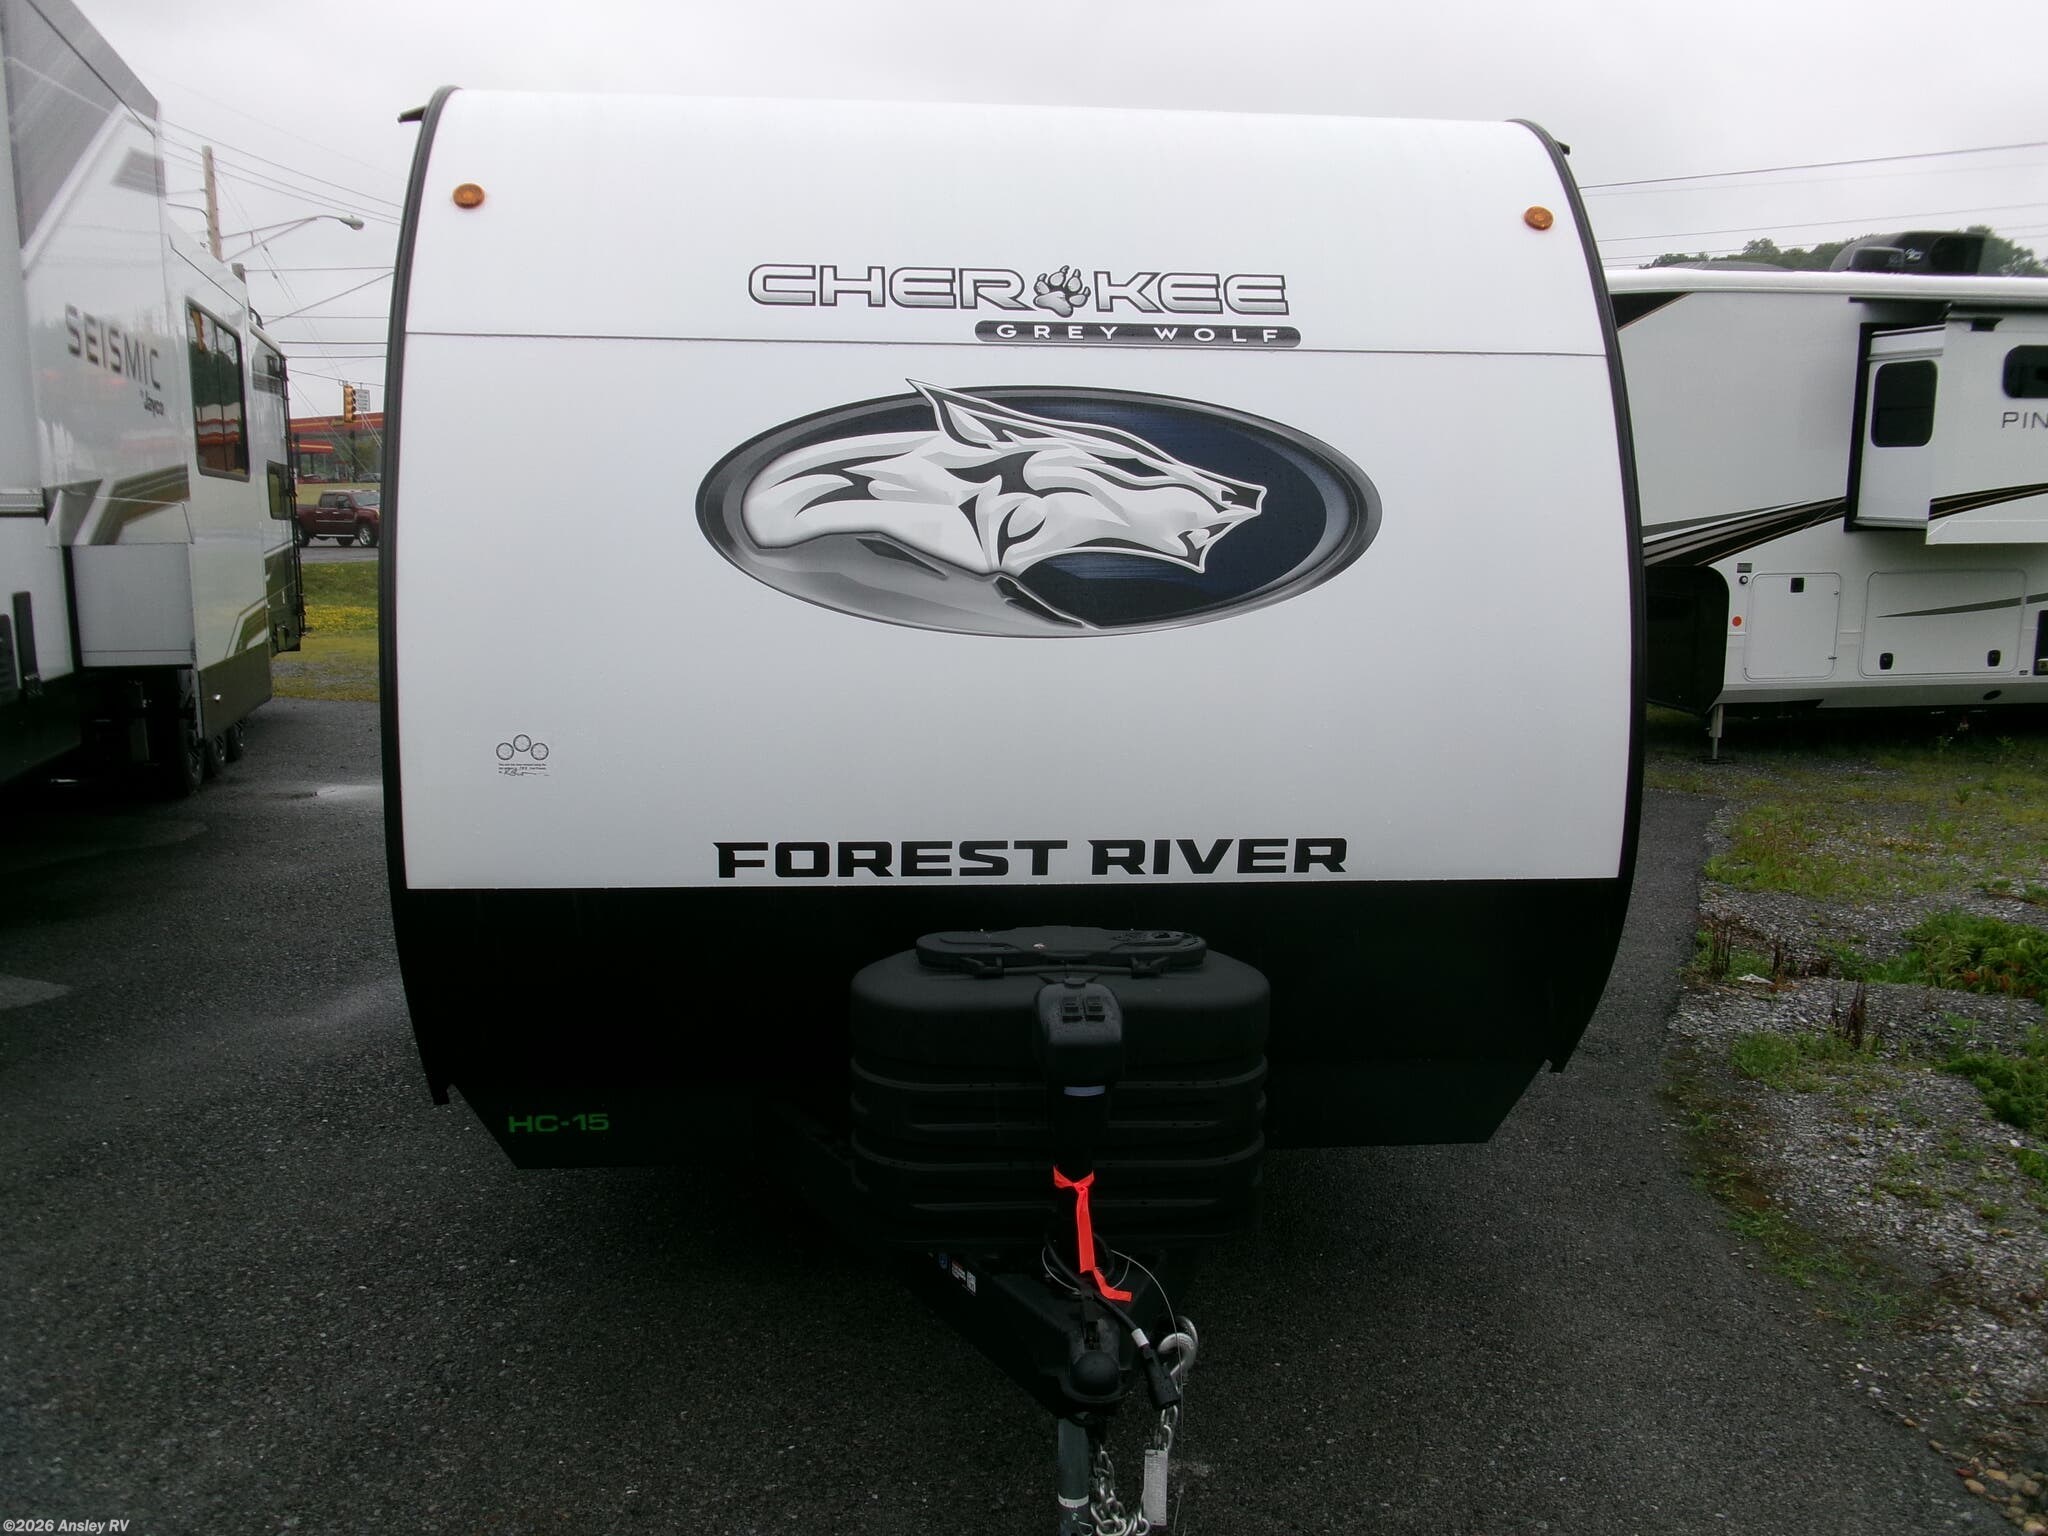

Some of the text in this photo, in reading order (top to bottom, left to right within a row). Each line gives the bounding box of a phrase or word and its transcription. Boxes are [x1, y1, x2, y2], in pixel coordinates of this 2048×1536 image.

[65, 303, 161, 392] SEISMIC
[996, 323, 1279, 344] GREY WOLF
[712, 837, 1348, 878] FOREST RIVER
[508, 1112, 609, 1133] HC-15
